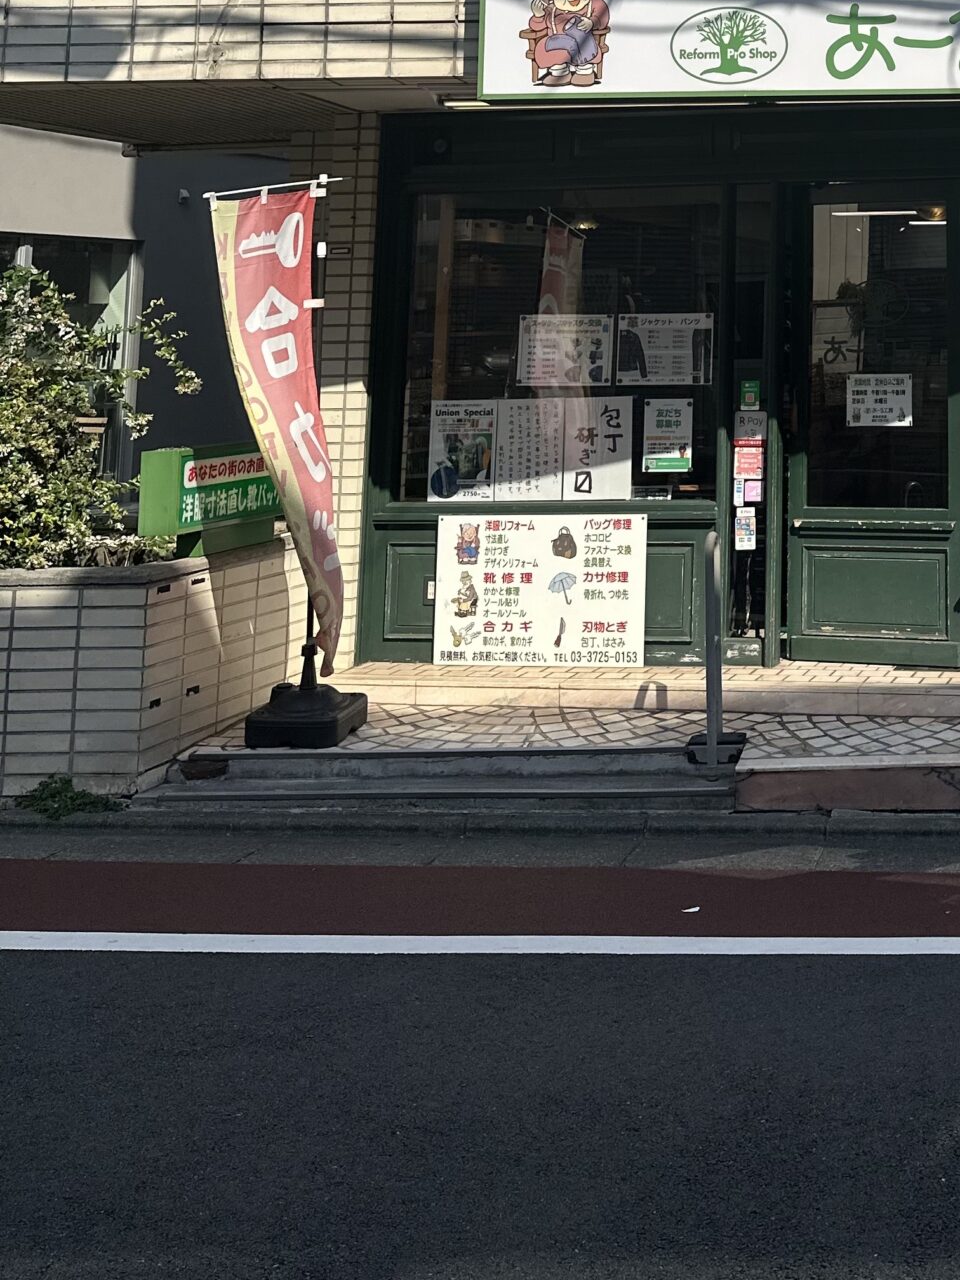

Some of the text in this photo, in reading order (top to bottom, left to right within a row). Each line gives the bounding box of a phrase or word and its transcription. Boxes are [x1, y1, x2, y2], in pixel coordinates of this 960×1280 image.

[679, 48, 777, 62] Reform Pro Shop
[435, 408, 494, 418] Union Special
[655, 408, 682, 418] 友だち
[600, 405, 623, 453] 包丁
[484, 520, 535, 531] 洋服リフォーム
[583, 518, 632, 530] バッグ修理
[485, 534, 510, 544] 寸法直し
[584, 533, 612, 543] ホコロビ
[484, 546, 509, 556] かけつぎ
[584, 545, 632, 556] ファスナー交換
[484, 558, 539, 568] デザインリフォーム
[583, 557, 612, 568] 金具替え
[483, 572, 533, 584] 靴修理
[583, 571, 629, 583] カサ修理
[483, 587, 520, 596] かかと修理
[583, 589, 629, 600] 骨折れ、つゆ先
[484, 597, 519, 607] ソール貼り
[483, 609, 527, 618] オールソール
[483, 620, 533, 633] 合カギ
[582, 621, 628, 633] 刃物とぎ
[581, 637, 625, 648] 包丁、はさみ
[439, 651, 638, 663] 見積無料、お気軽にご相談ください。 TEL 03-3725-0153
